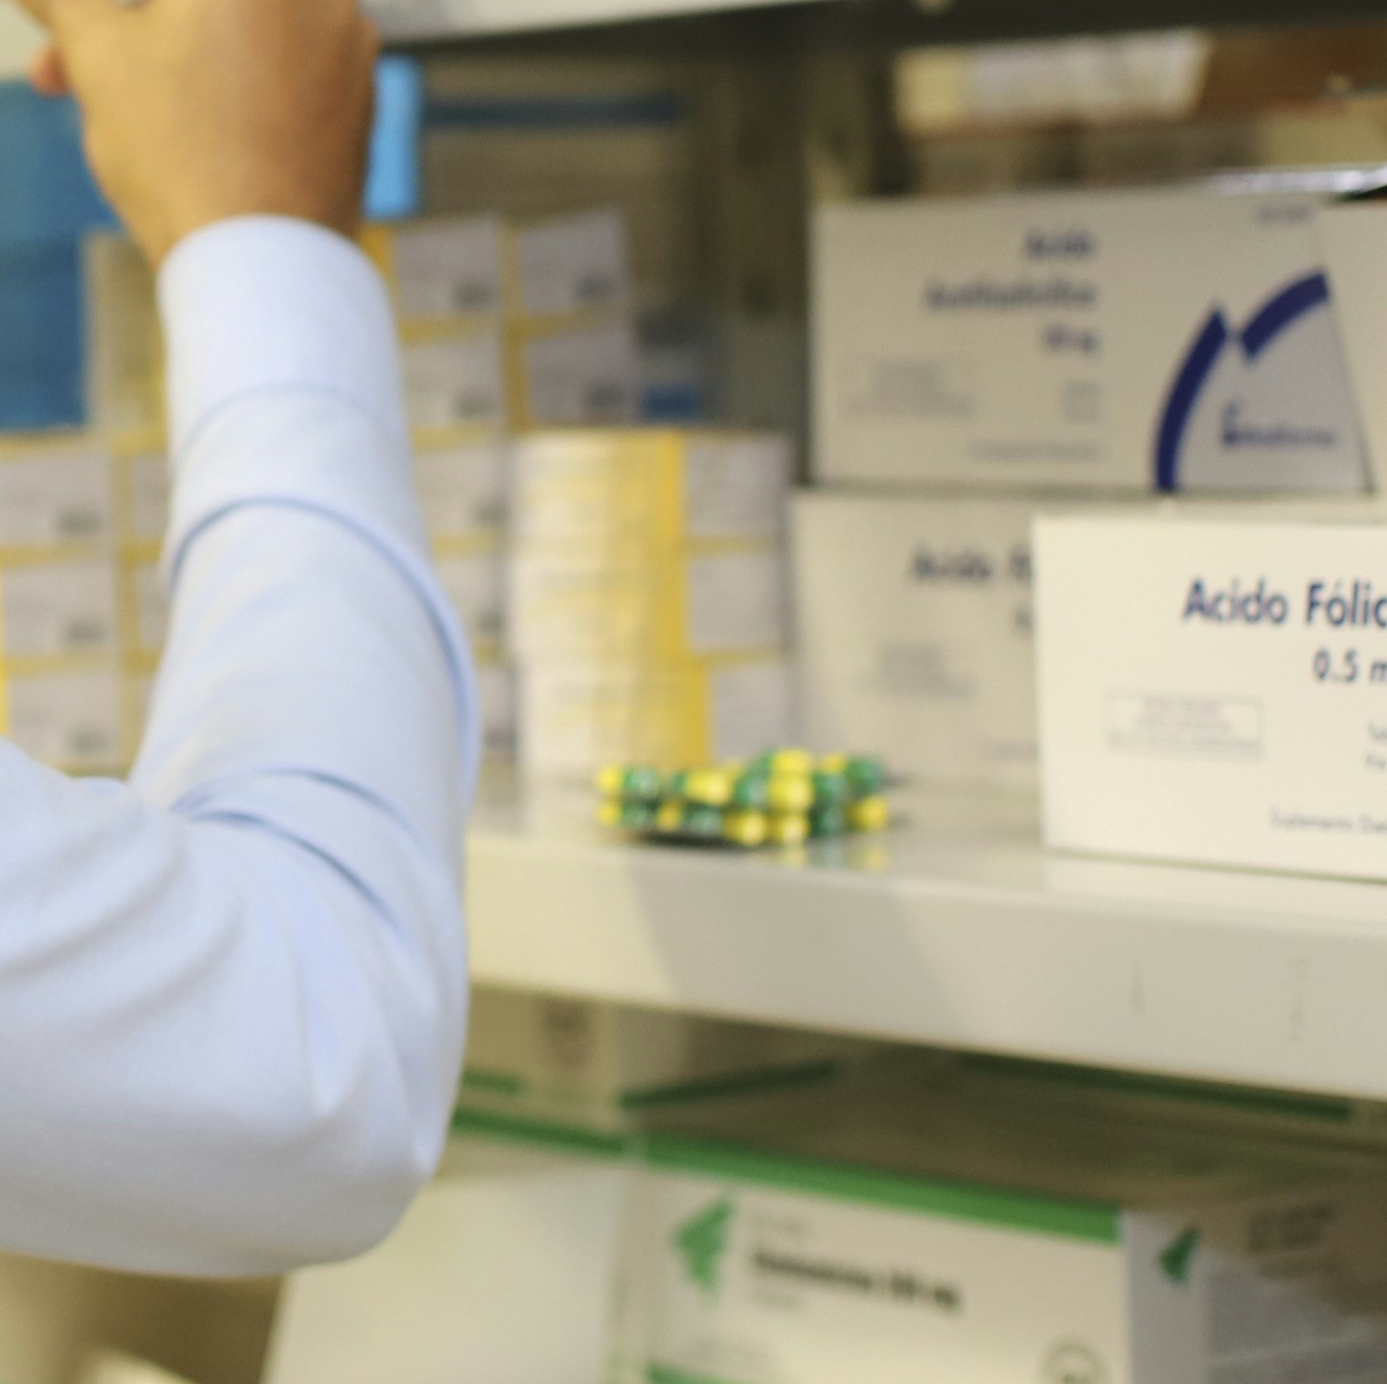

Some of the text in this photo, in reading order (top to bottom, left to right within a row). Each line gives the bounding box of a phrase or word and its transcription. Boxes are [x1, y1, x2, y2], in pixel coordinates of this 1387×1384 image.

[1181, 577, 1387, 628] Acido Fólic
[1312, 646, 1387, 684] 0.5 m
